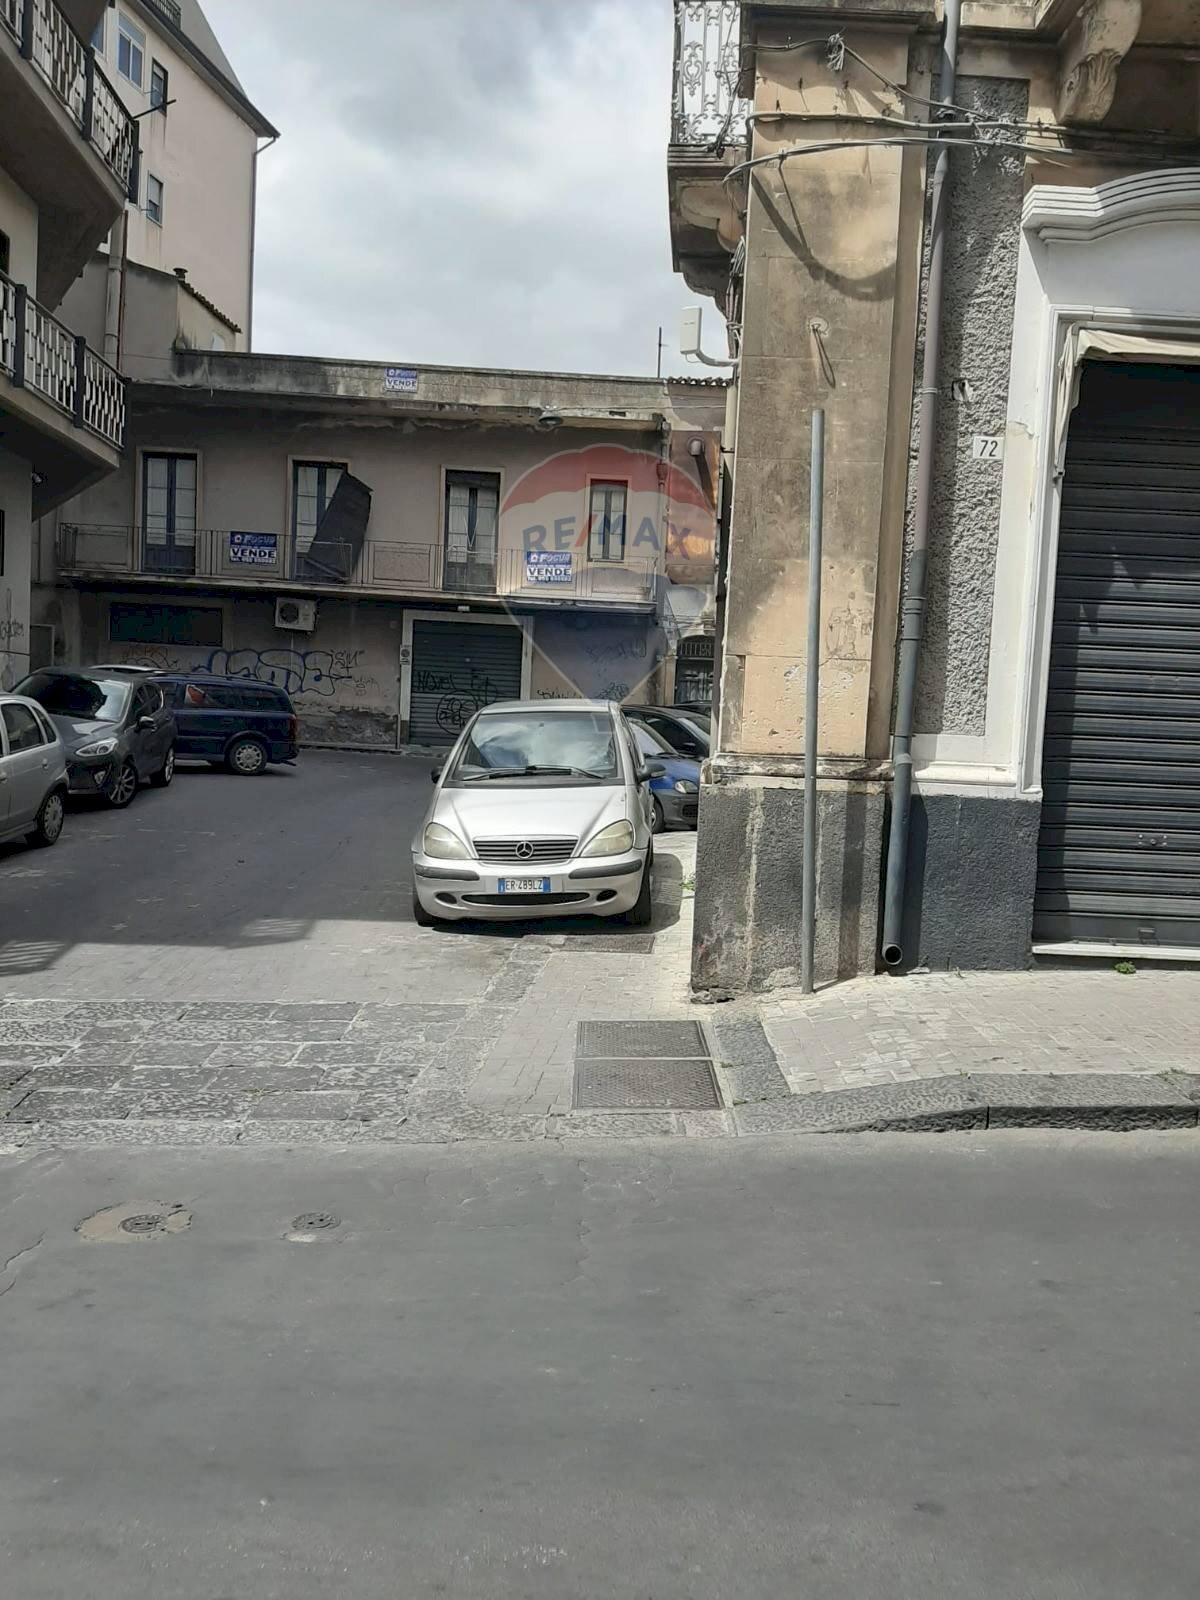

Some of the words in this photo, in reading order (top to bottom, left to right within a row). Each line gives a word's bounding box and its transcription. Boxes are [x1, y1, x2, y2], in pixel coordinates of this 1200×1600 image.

[387, 379, 417, 387] VENDE
[980, 440, 998, 457] 72
[231, 548, 276, 559] VENDE
[528, 568, 572, 577] VENDE
